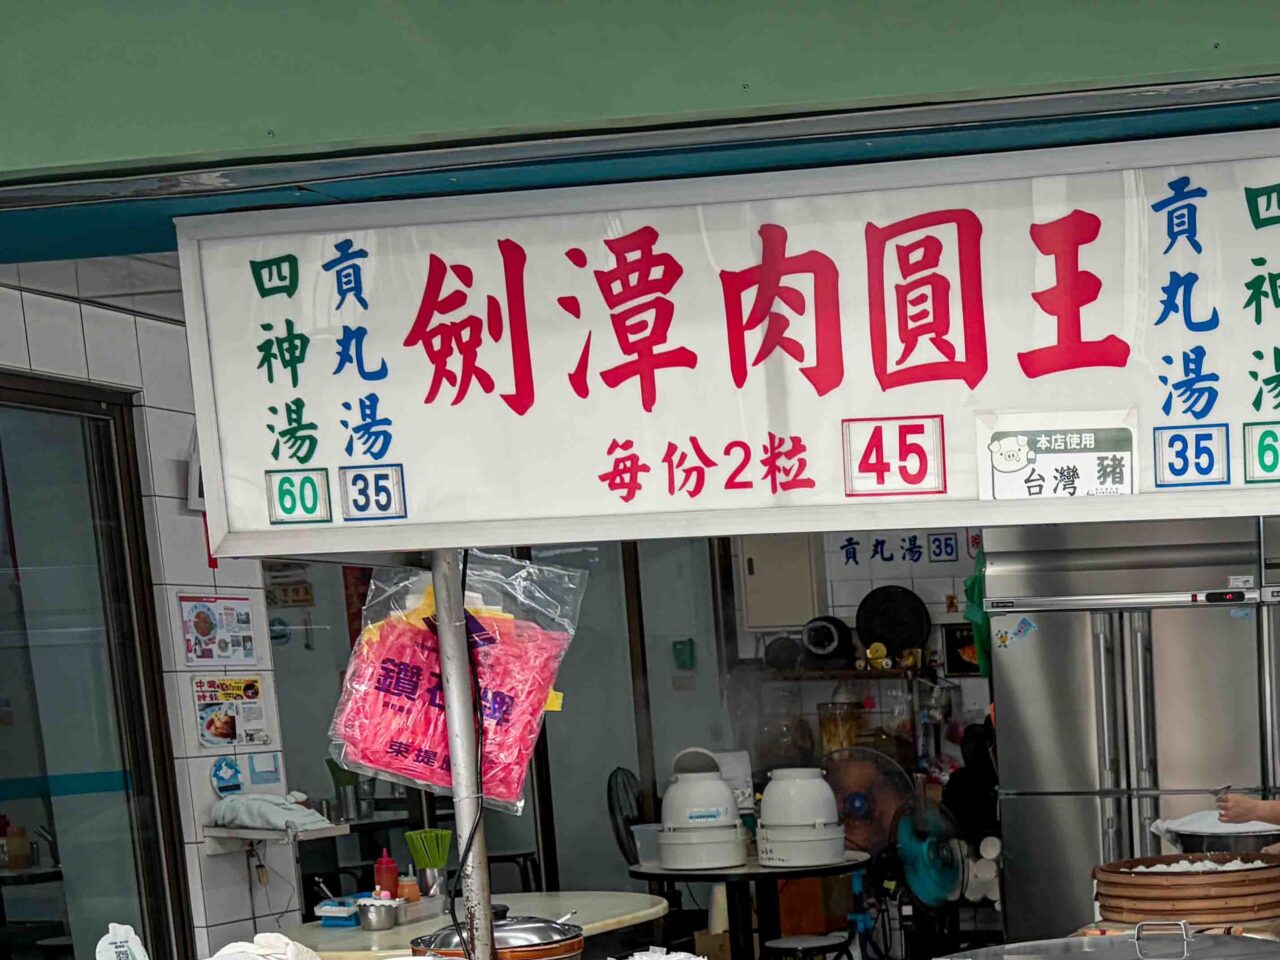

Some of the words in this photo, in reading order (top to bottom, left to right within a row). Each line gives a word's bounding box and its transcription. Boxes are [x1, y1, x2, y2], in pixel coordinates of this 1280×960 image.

[403, 207, 1132, 417] 劍潭肉圓王
[1151, 176, 1221, 421] 貢丸湯
[249, 253, 319, 464] 四神湯
[321, 238, 395, 461] 貢丸湯
[1035, 433, 1095, 449] 本店使用
[1167, 434, 1216, 475] 35
[598, 432, 816, 503] 每份2粒
[856, 424, 930, 486] 45
[1024, 465, 1080, 497] 台灣
[1096, 455, 1125, 486] 豬
[277, 473, 319, 515] 60
[350, 470, 393, 512] 35
[839, 534, 923, 566] 貢丸湯
[931, 537, 955, 557] 35
